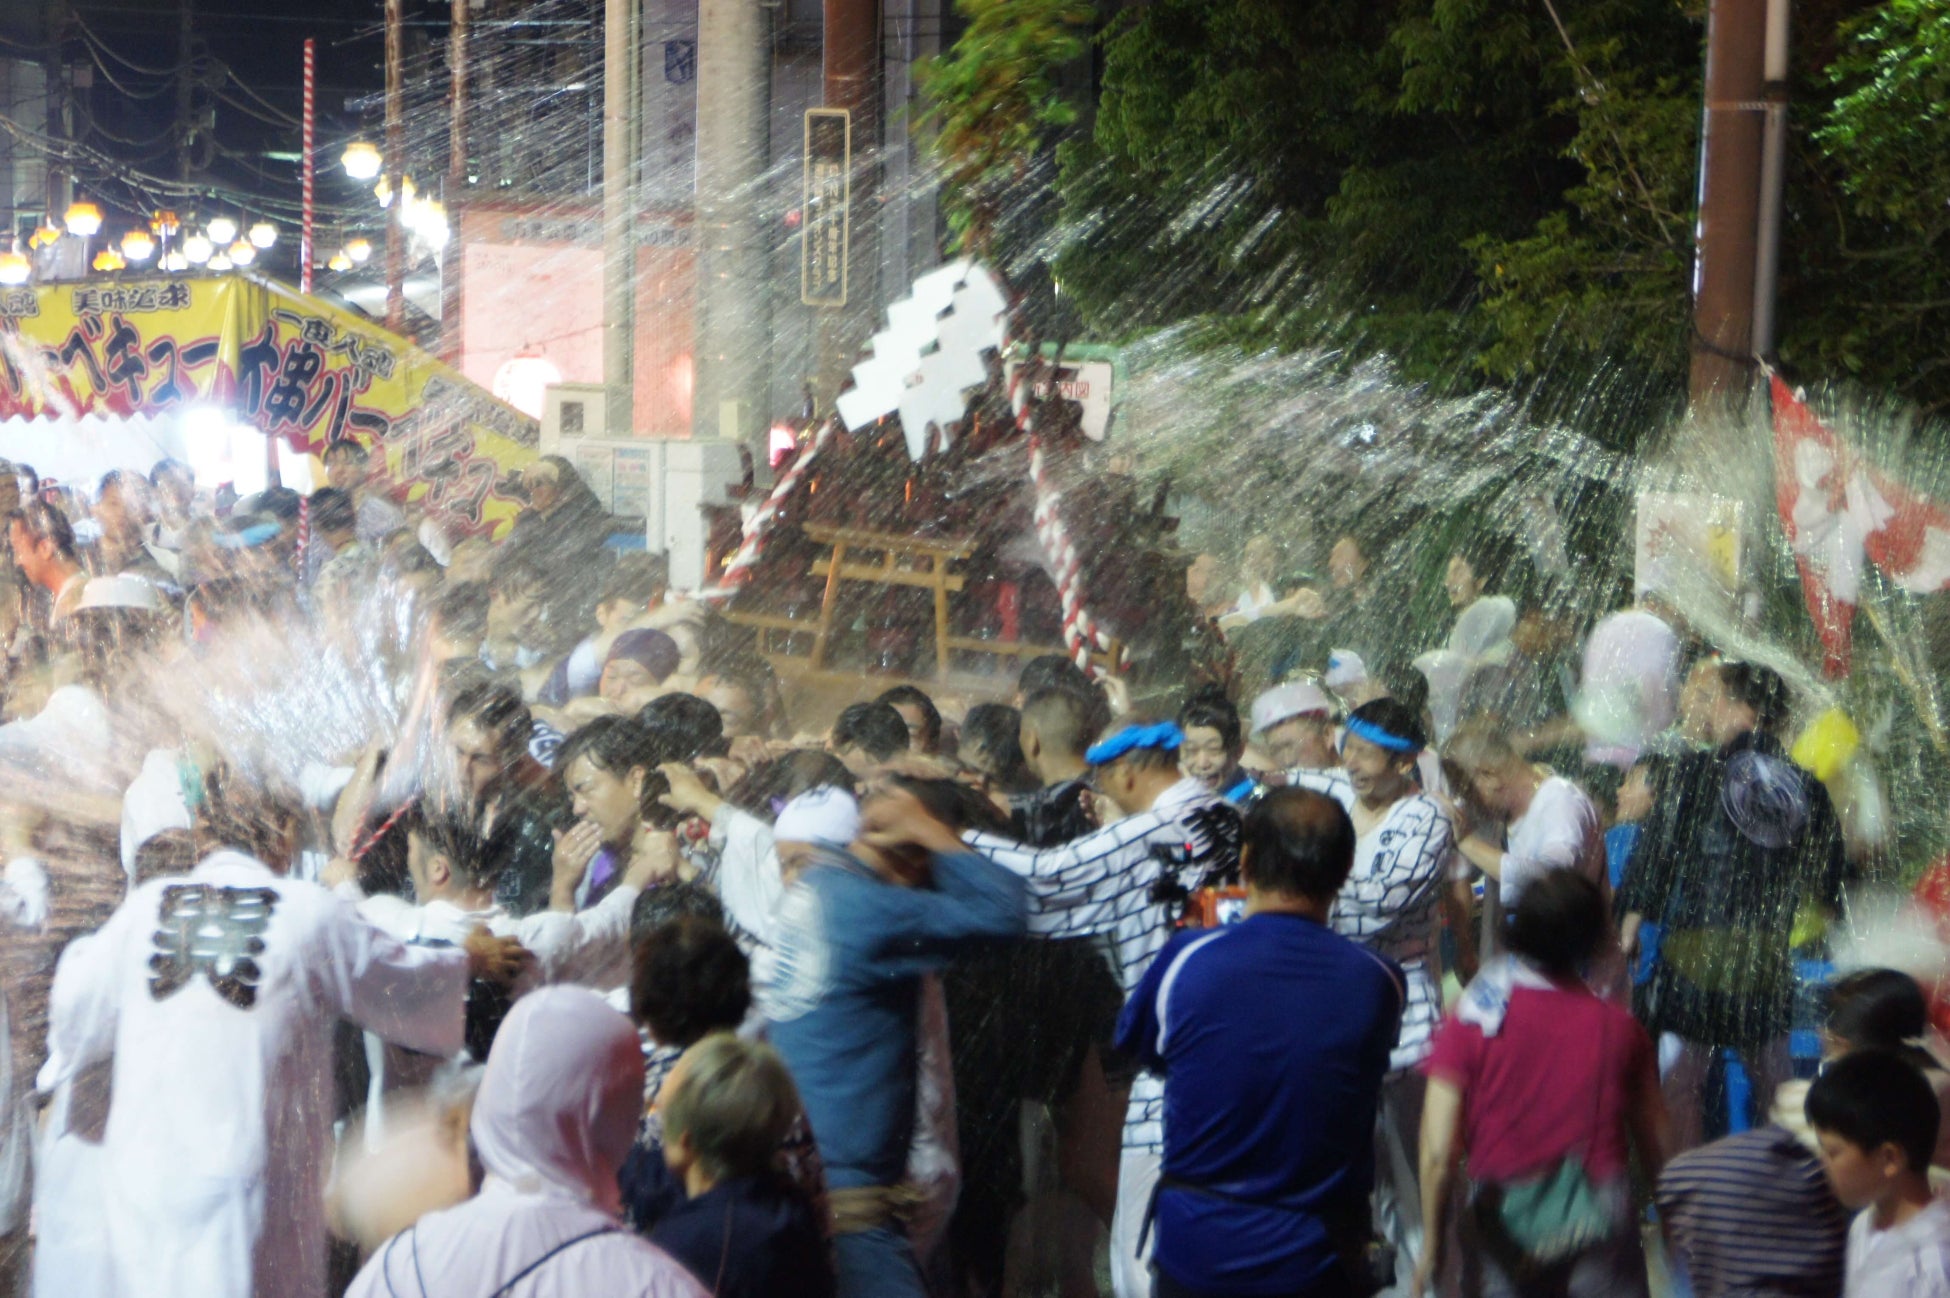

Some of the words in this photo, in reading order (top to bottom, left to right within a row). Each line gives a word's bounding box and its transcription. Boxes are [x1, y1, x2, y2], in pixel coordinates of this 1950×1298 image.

[0, 292, 38, 317] 魂
[73, 284, 191, 315] 美味追求
[1, 315, 220, 404] ベキュー
